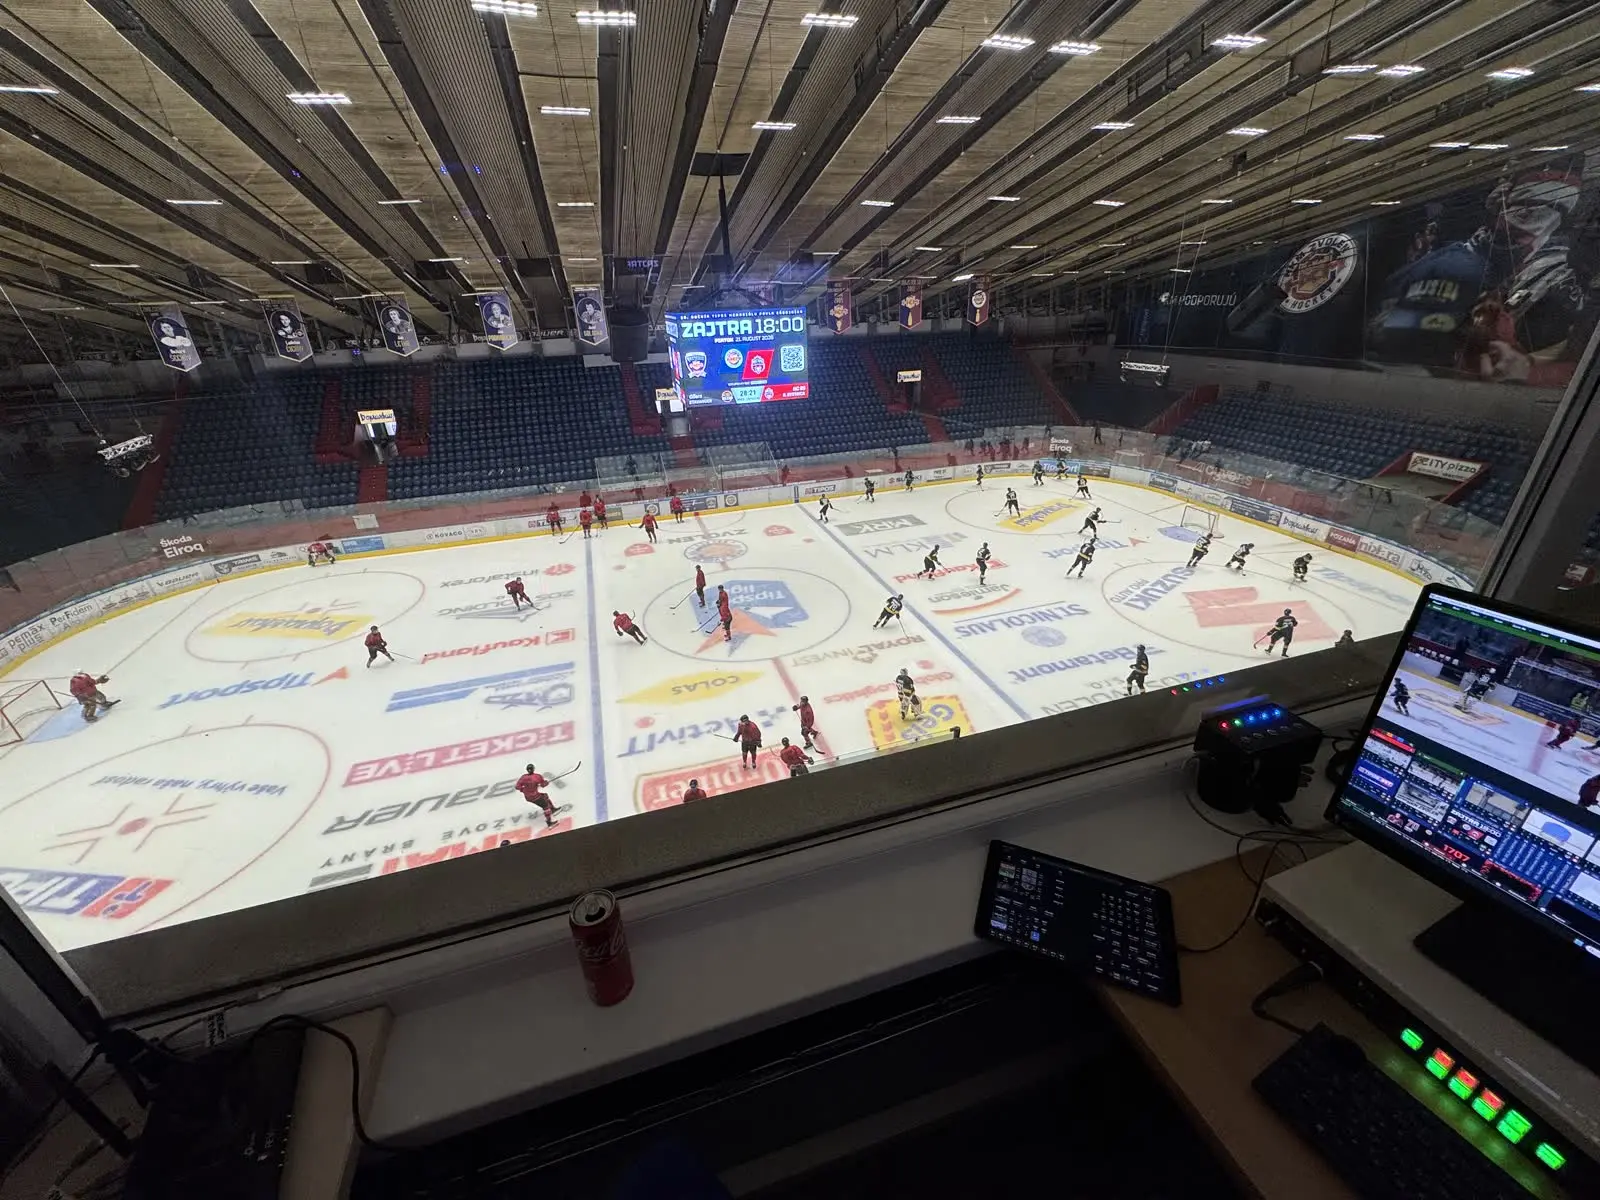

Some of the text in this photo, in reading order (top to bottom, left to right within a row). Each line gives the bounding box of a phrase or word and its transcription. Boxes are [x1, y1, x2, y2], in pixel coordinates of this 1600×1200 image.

[1290, 286, 1333, 309] HOCKEY
[681, 316, 804, 338] ZAJTRA 18:00
[1049, 444, 1072, 453] Elroq
[852, 518, 913, 534] MRK
[159, 535, 193, 548] Škoda
[668, 528, 747, 545] ZVOLEN
[163, 543, 205, 559] Elroq
[864, 541, 931, 558] KLM
[440, 569, 539, 589] instaforex
[1123, 567, 1195, 611] SUZUKI
[927, 584, 1010, 603] Jamieson
[1109, 588, 1132, 604] AUTO
[437, 598, 514, 617] OLDING
[954, 603, 1092, 638] ST.NICOLAUS
[421, 635, 541, 665] Kaufland
[792, 634, 925, 667] ROYAL INVEST
[1008, 647, 1137, 682] Betamont
[156, 671, 316, 711] Tipsport
[672, 674, 740, 696] COLAS
